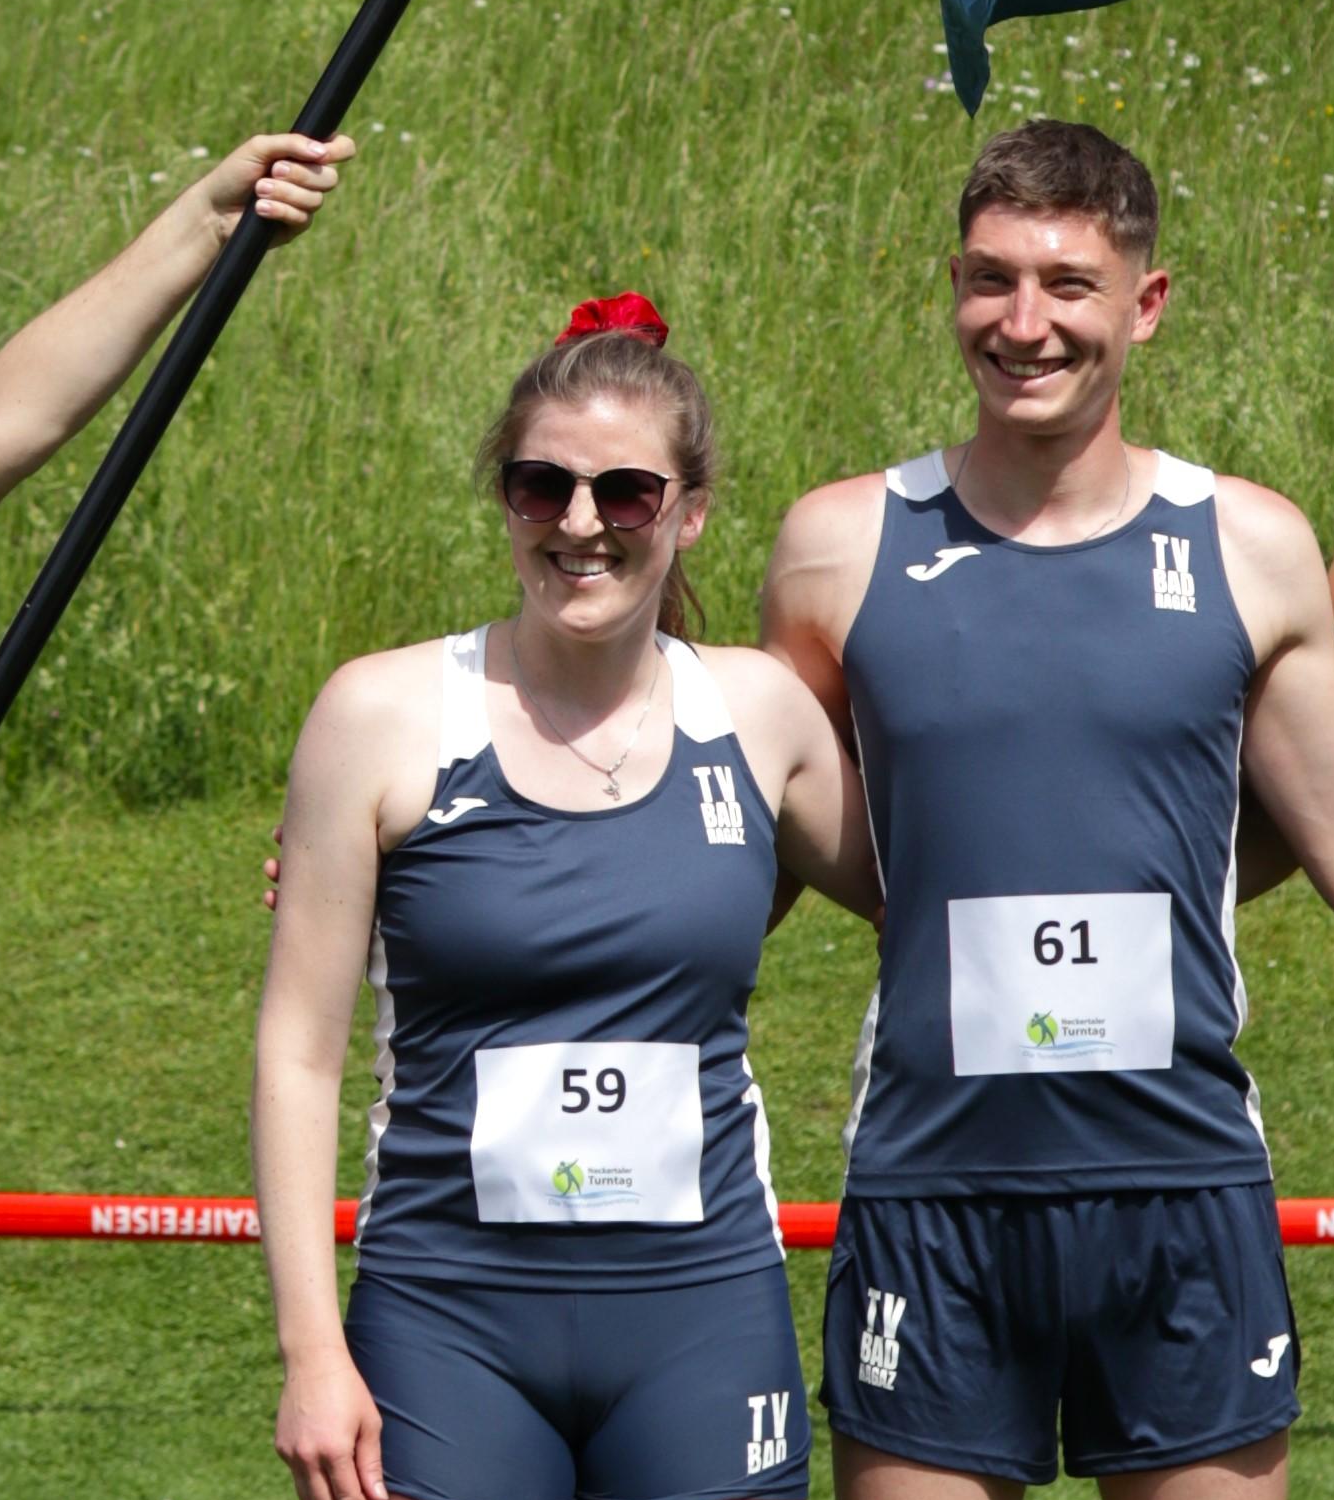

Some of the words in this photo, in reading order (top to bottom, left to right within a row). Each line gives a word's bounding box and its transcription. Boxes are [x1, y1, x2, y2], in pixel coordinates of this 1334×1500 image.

[1151, 532, 1190, 573] TV
[1152, 568, 1196, 597] BAD
[692, 765, 736, 802] TV
[700, 800, 744, 829] BAD
[1033, 919, 1099, 967] 61
[1062, 1026, 1107, 1039] Turntag
[561, 1067, 628, 1115] 59
[587, 1175, 634, 1188] Turntag
[91, 1204, 260, 1236] RAIFFEISEN
[867, 1286, 908, 1339] TV
[859, 1330, 900, 1370] BAD
[747, 1391, 790, 1442] TV
[746, 1438, 788, 1475] BAD
